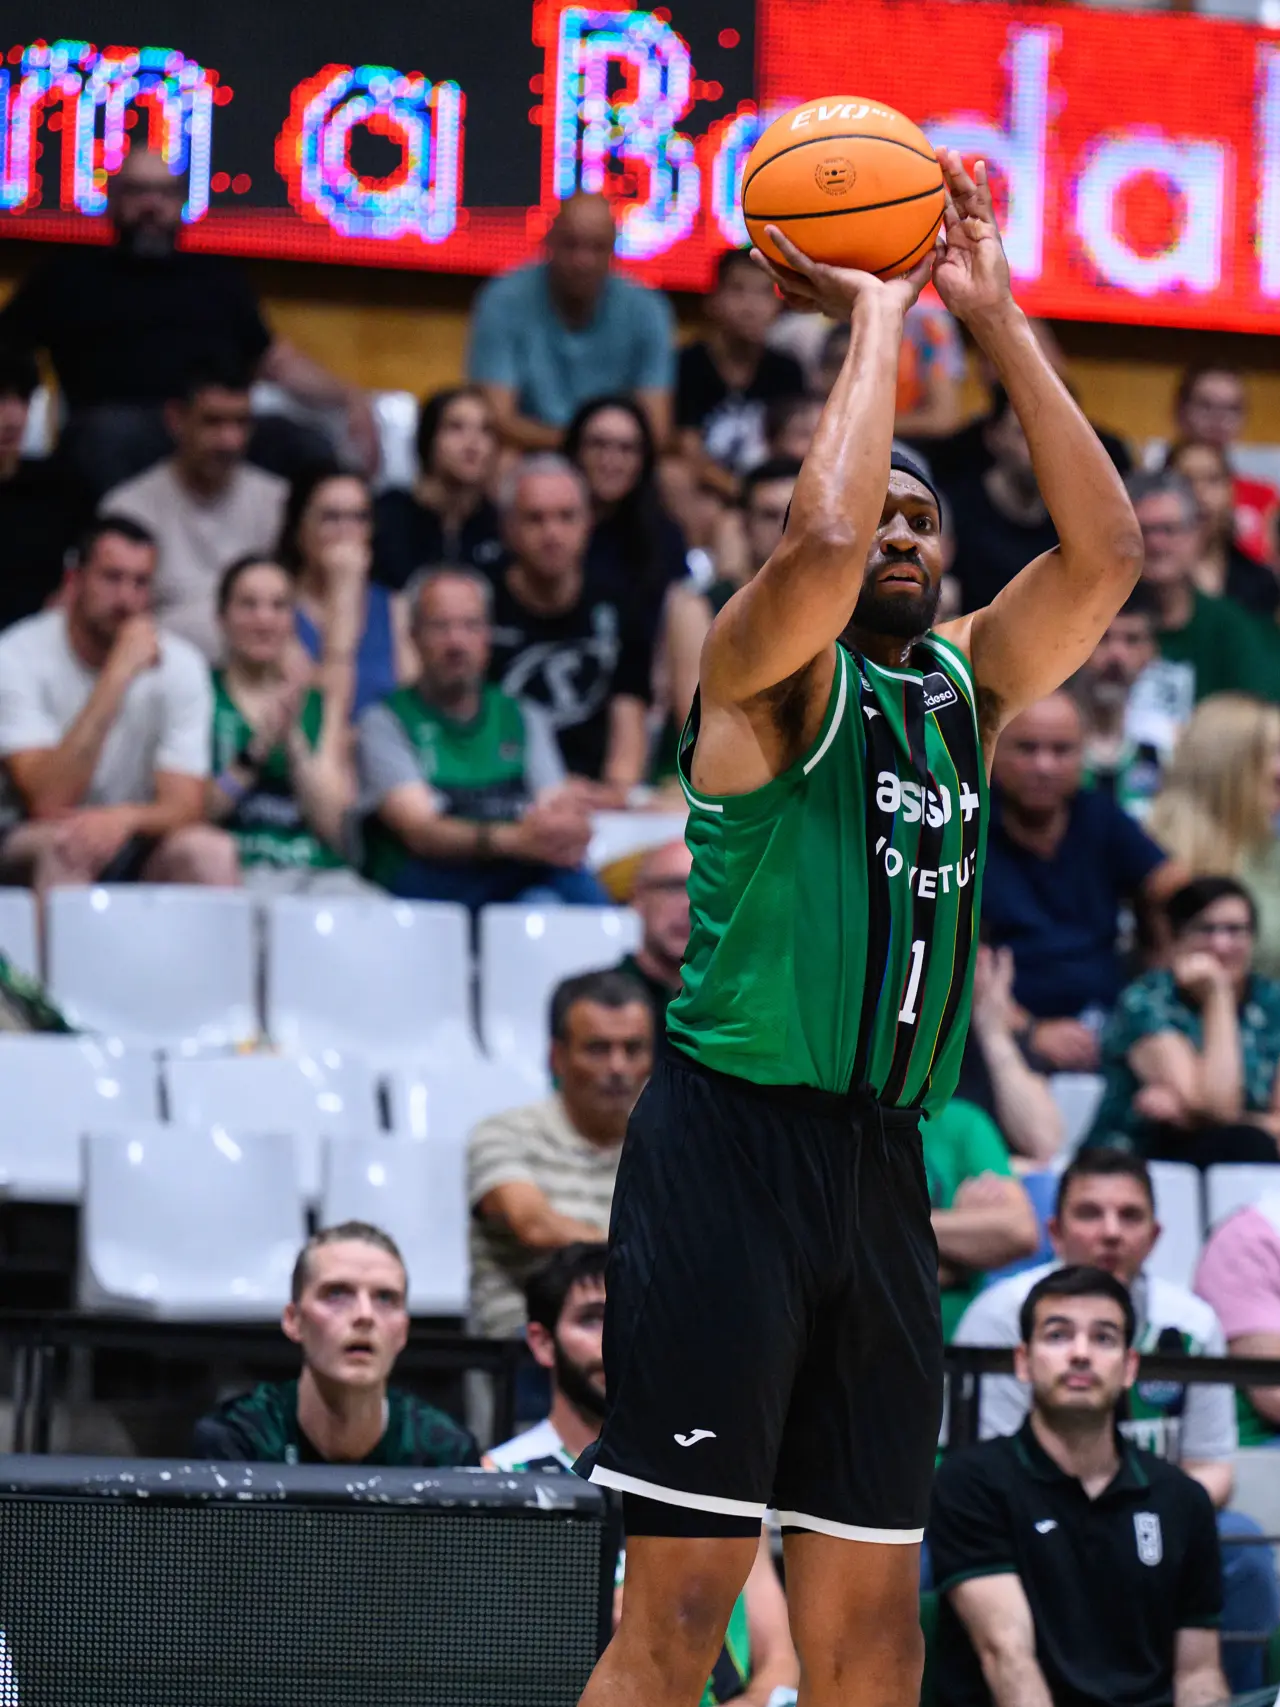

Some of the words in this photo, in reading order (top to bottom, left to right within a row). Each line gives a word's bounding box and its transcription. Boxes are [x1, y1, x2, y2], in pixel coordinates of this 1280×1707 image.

[294, 65, 463, 243] a
[791, 104, 870, 131] EVO
[898, 939, 926, 1025] 1
